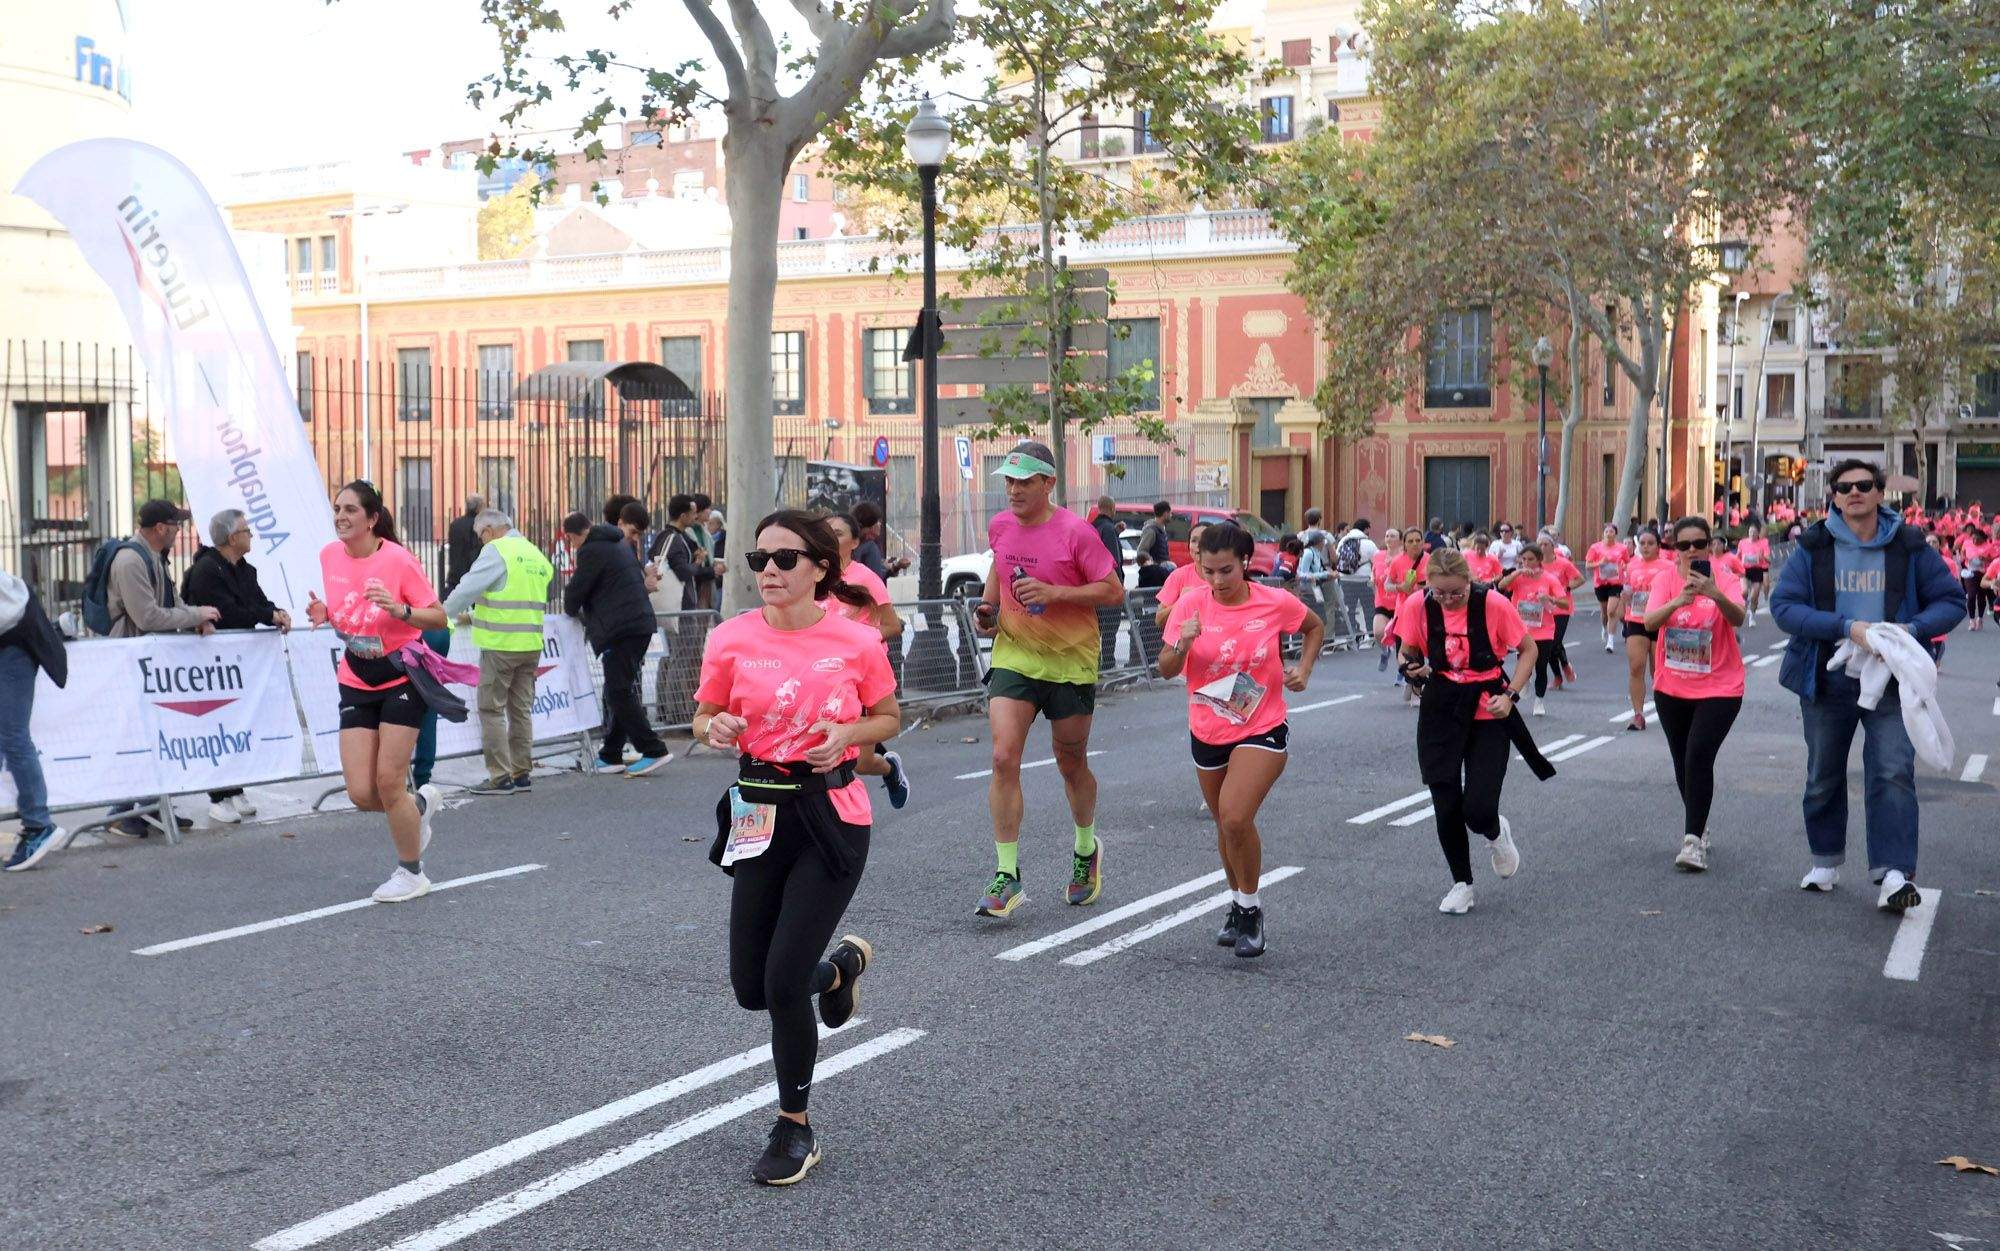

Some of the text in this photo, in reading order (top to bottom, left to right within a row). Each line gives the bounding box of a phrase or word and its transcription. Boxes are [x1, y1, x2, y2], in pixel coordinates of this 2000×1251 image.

[959, 440, 970, 466] P
[138, 655, 243, 694] Eucerin
[743, 659, 781, 669] OYSHO
[159, 723, 252, 771] Aquaphor
